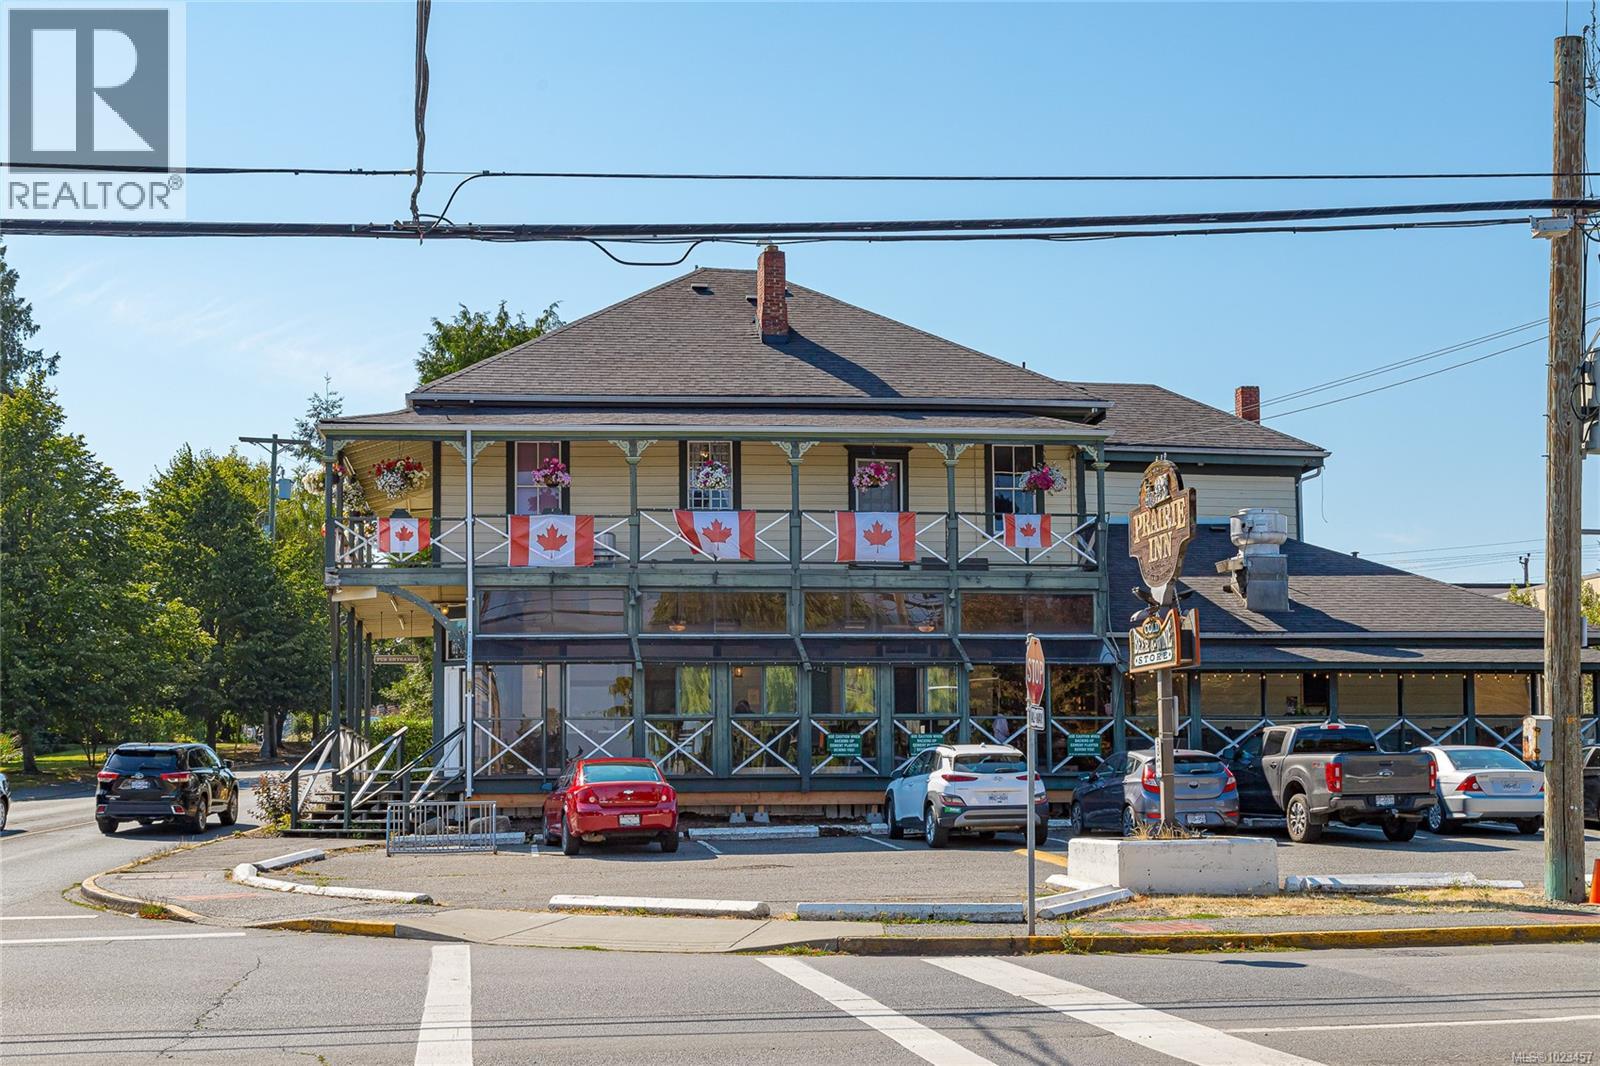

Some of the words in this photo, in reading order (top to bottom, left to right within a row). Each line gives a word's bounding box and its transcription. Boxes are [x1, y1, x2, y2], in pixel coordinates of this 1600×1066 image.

[1133, 497, 1186, 544] PRAIRIE
[1148, 531, 1173, 563] INN
[1144, 623, 1160, 634] COLD
[1027, 657, 1044, 685] STOP
[1138, 651, 1168, 665] STORE
